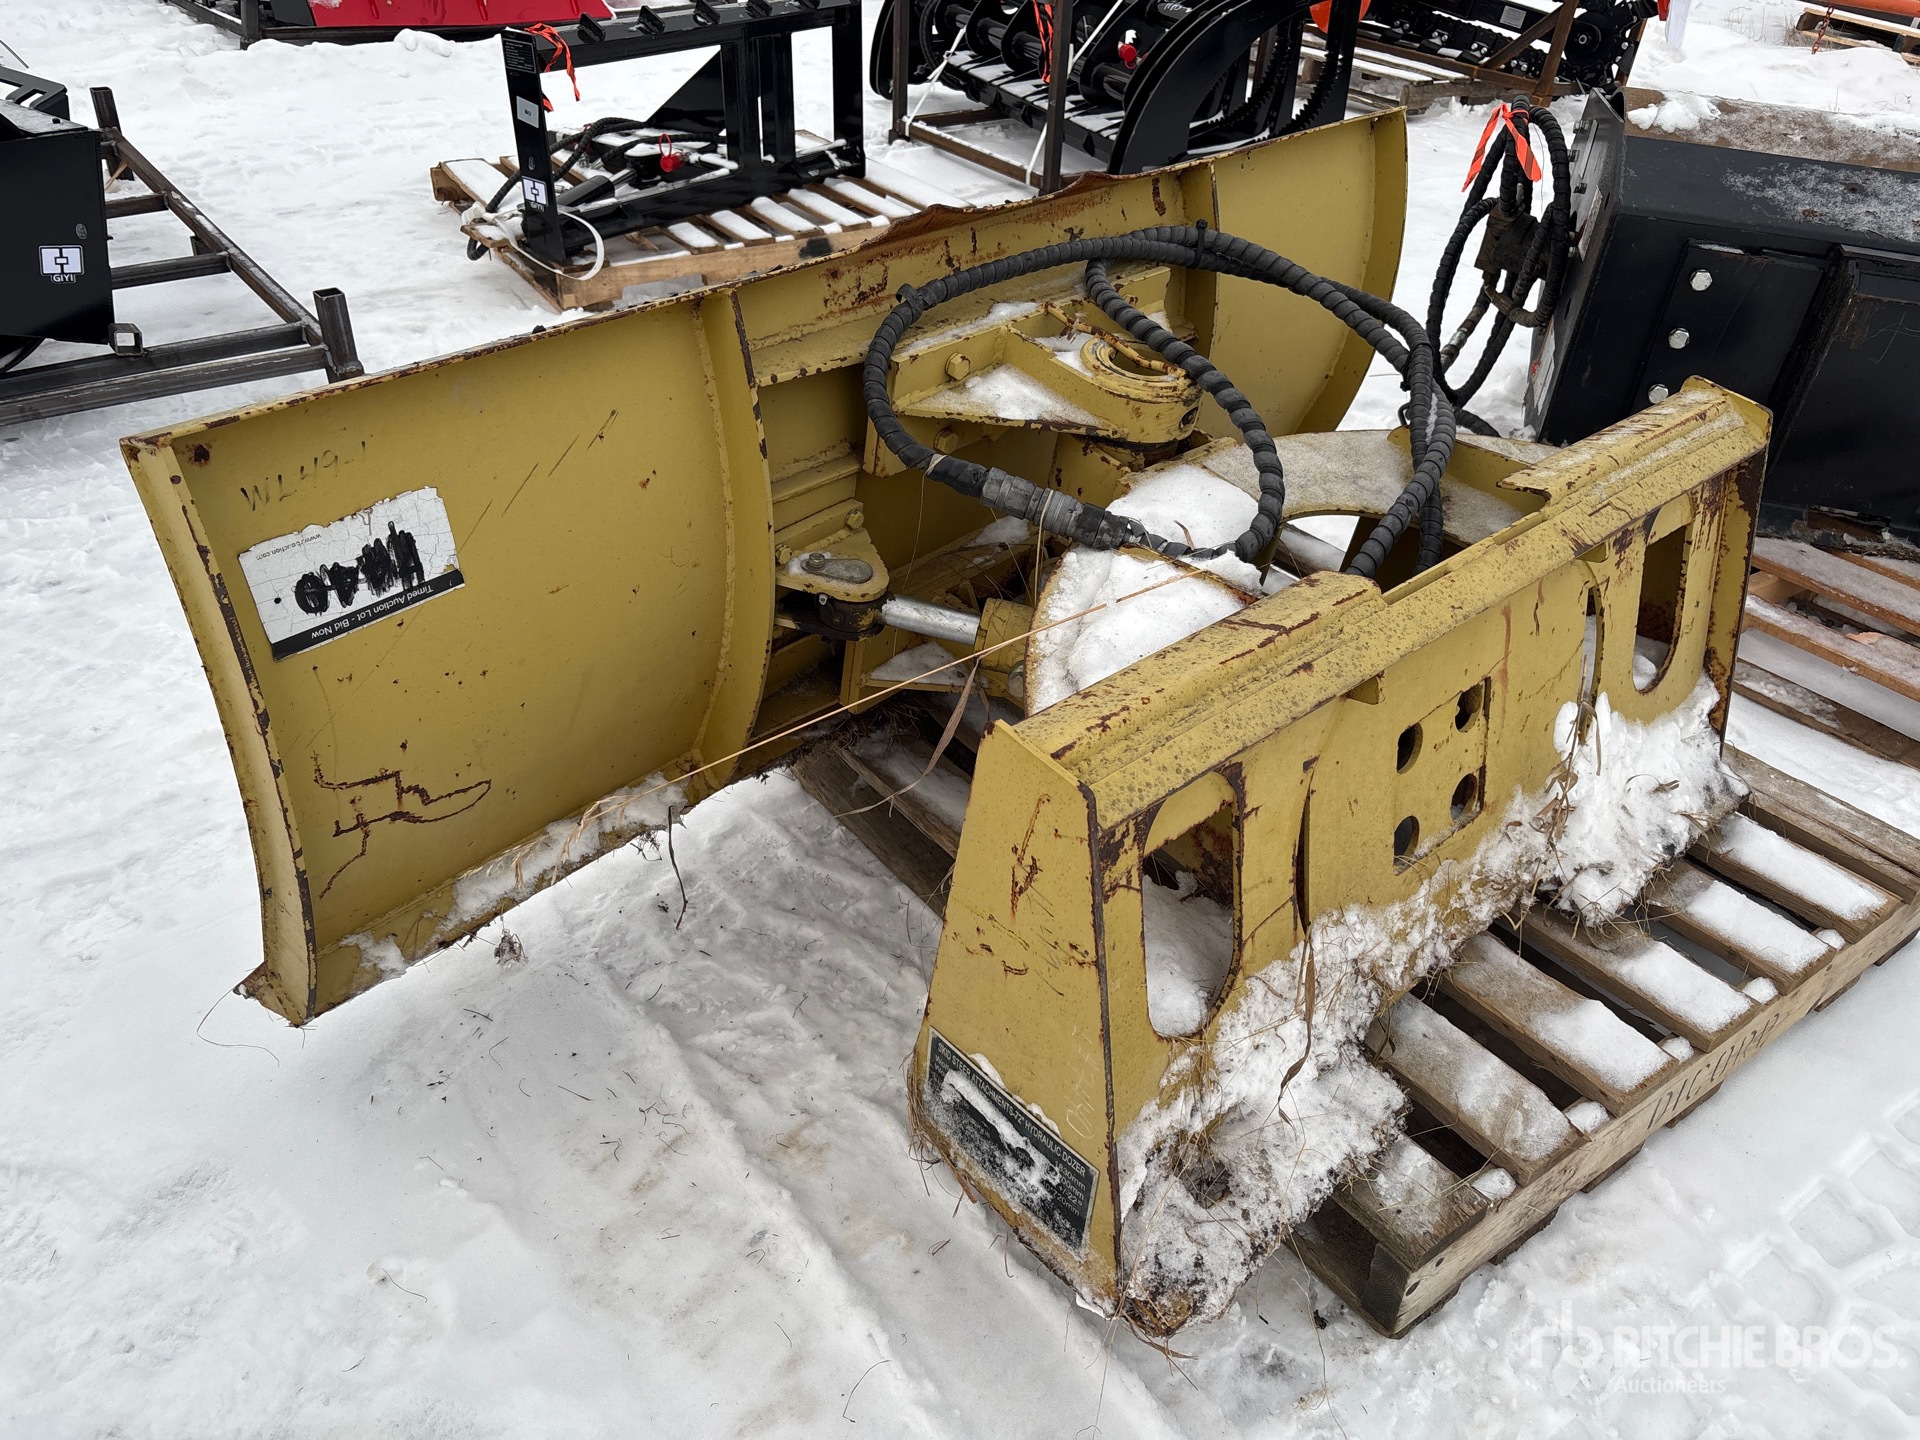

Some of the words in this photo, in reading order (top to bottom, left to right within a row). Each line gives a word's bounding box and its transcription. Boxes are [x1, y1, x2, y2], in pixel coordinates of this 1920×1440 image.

[53, 274, 74, 282] GIYI
[406, 584, 434, 601] Timed
[373, 595, 406, 614] Auction
[356, 606, 372, 621] Lot
[311, 625, 333, 639] Now
[334, 618, 350, 633] Bid
[937, 1042, 951, 1060] SKID
[951, 1055, 971, 1077] STEER
[1024, 1119, 1061, 1157] HYDRAULIC
[1062, 1151, 1086, 1177] DOZER
